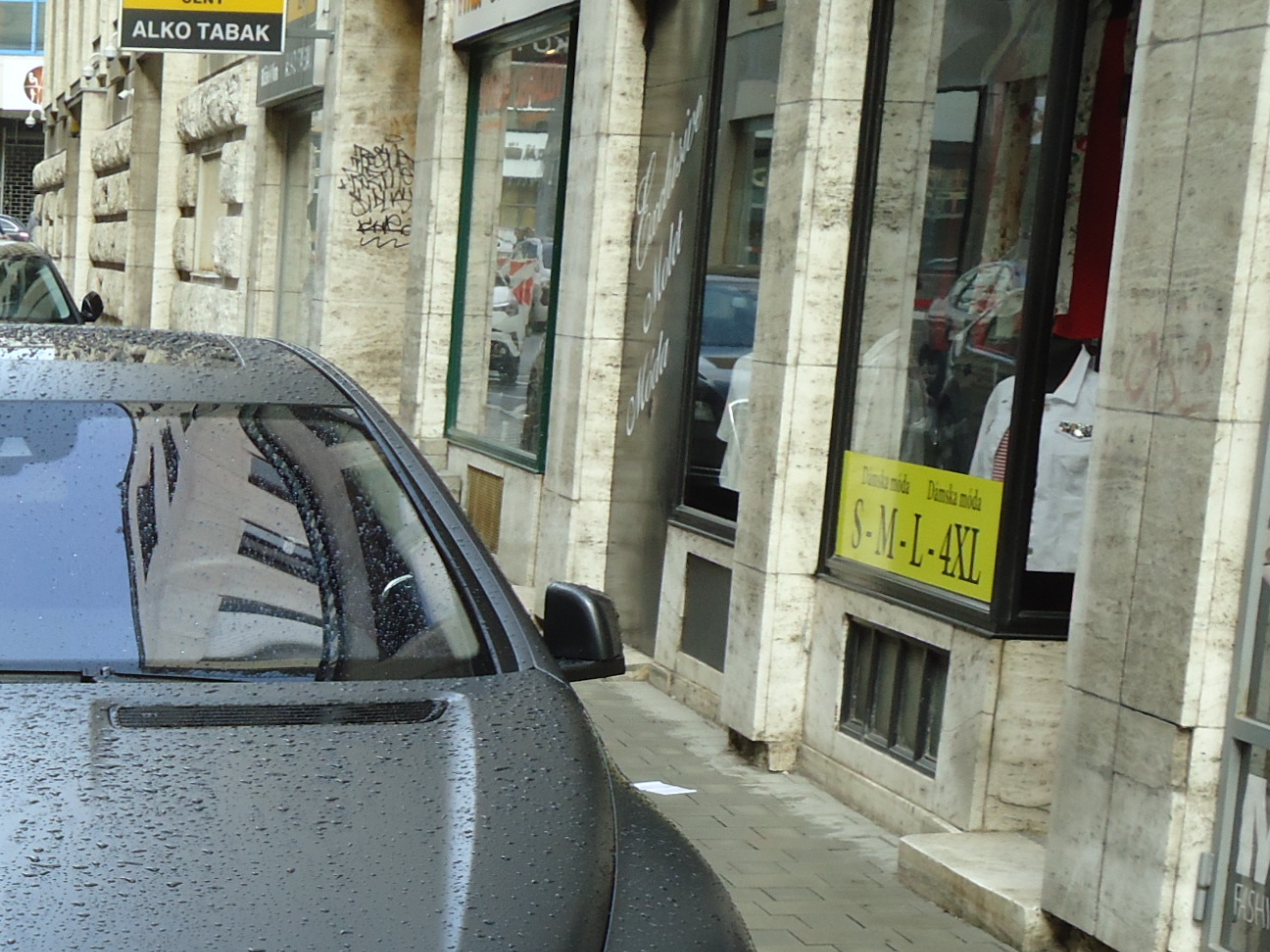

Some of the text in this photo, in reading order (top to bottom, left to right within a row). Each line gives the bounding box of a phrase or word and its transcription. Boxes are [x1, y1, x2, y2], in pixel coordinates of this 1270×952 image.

[132, 20, 270, 42] ALKO TABAK
[927, 480, 958, 506] Dámska
[959, 488, 982, 511] móda
